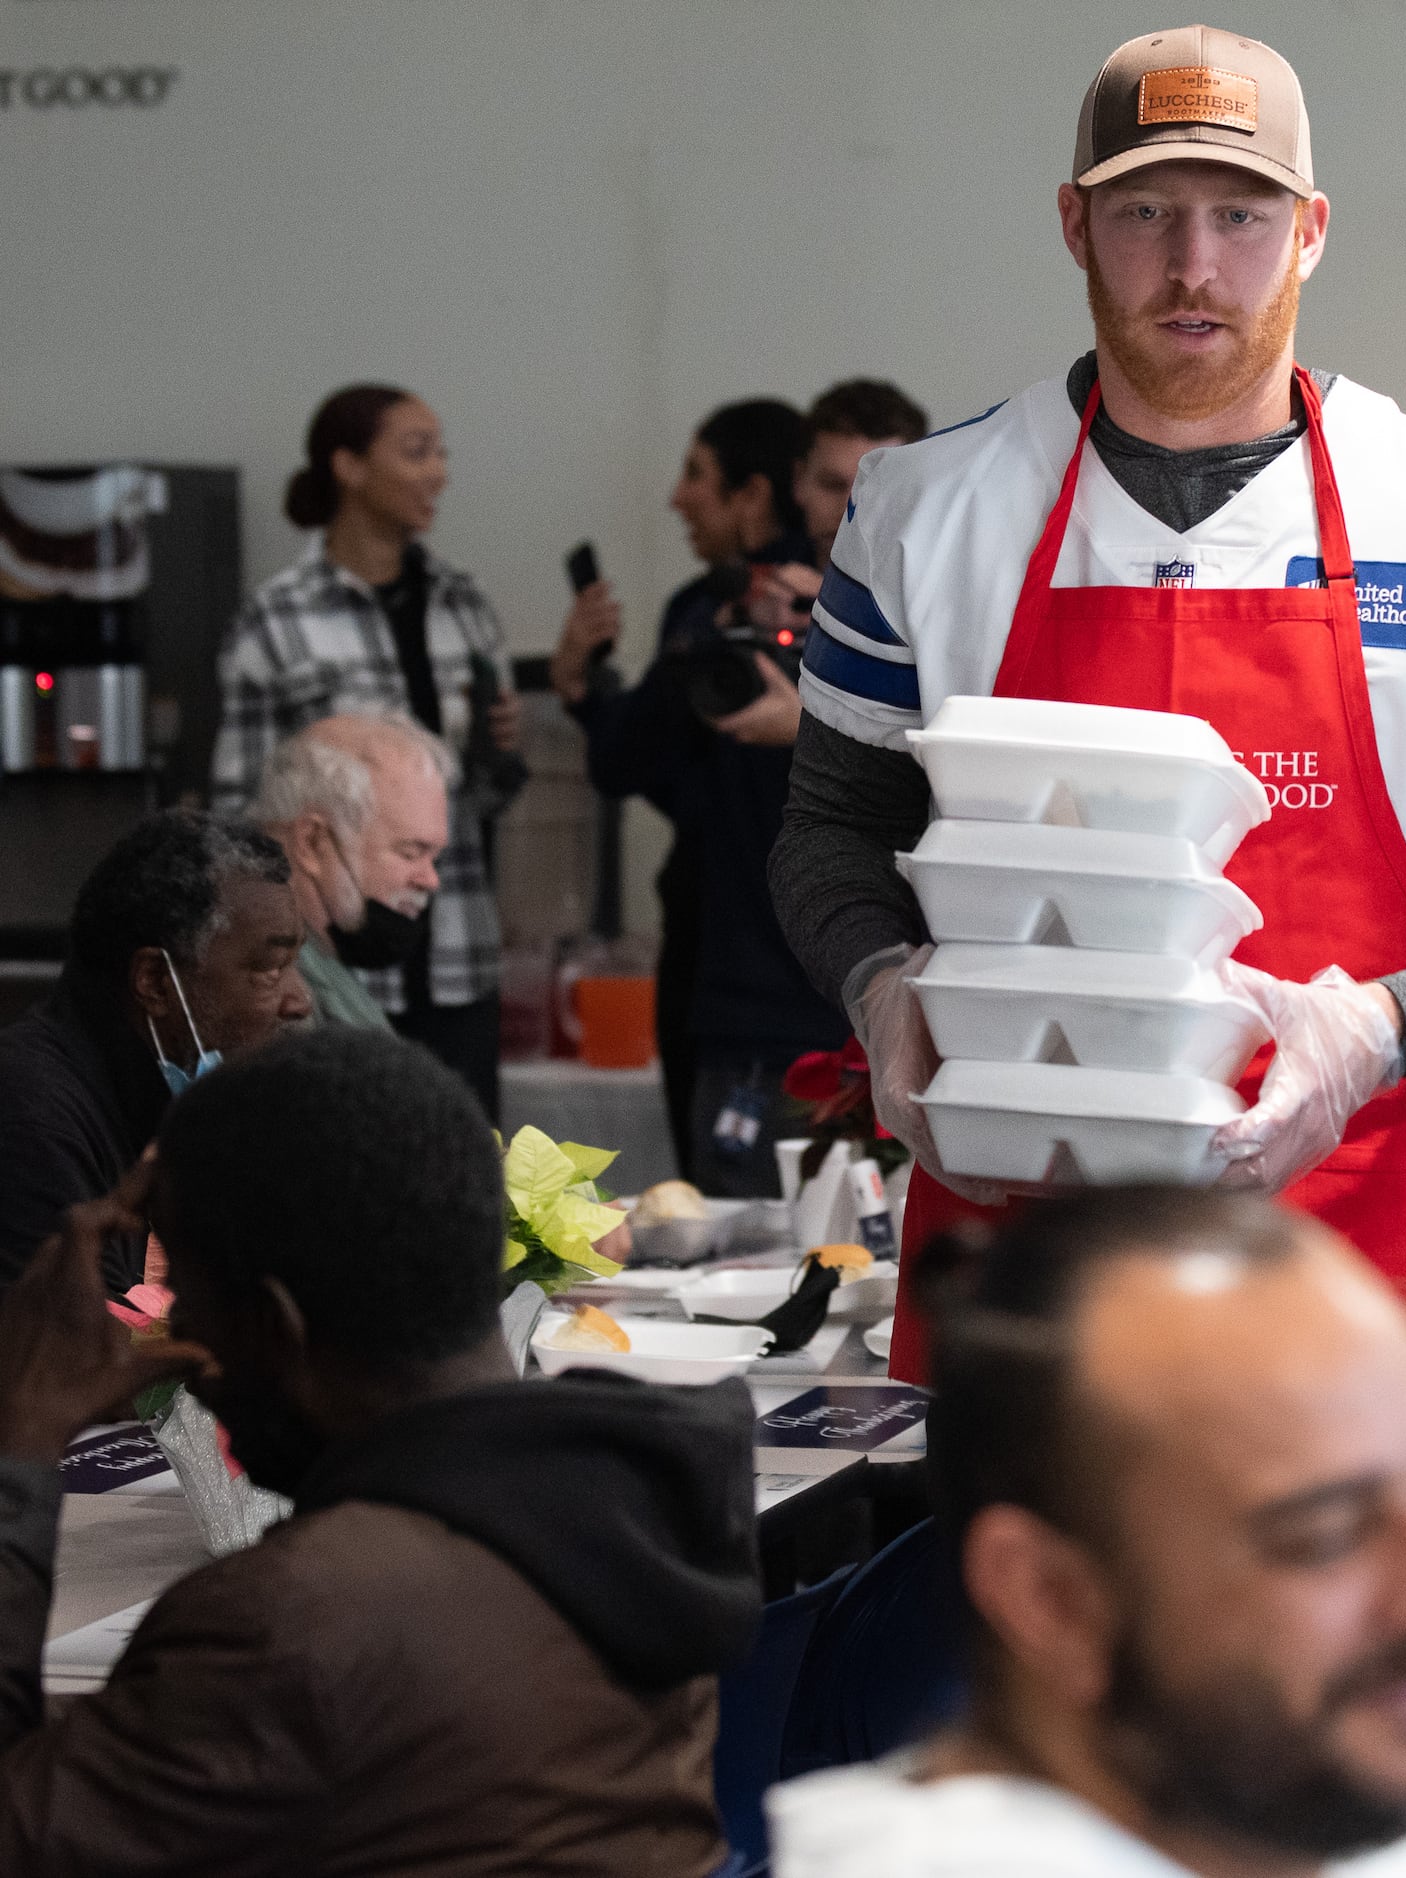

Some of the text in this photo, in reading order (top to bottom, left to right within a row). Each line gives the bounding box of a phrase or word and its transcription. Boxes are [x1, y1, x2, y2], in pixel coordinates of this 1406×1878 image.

[21, 63, 173, 110] GOOD
[1148, 94, 1246, 113] LUCCHESE
[1355, 582, 1403, 604] nited
[1252, 751, 1319, 777] THE
